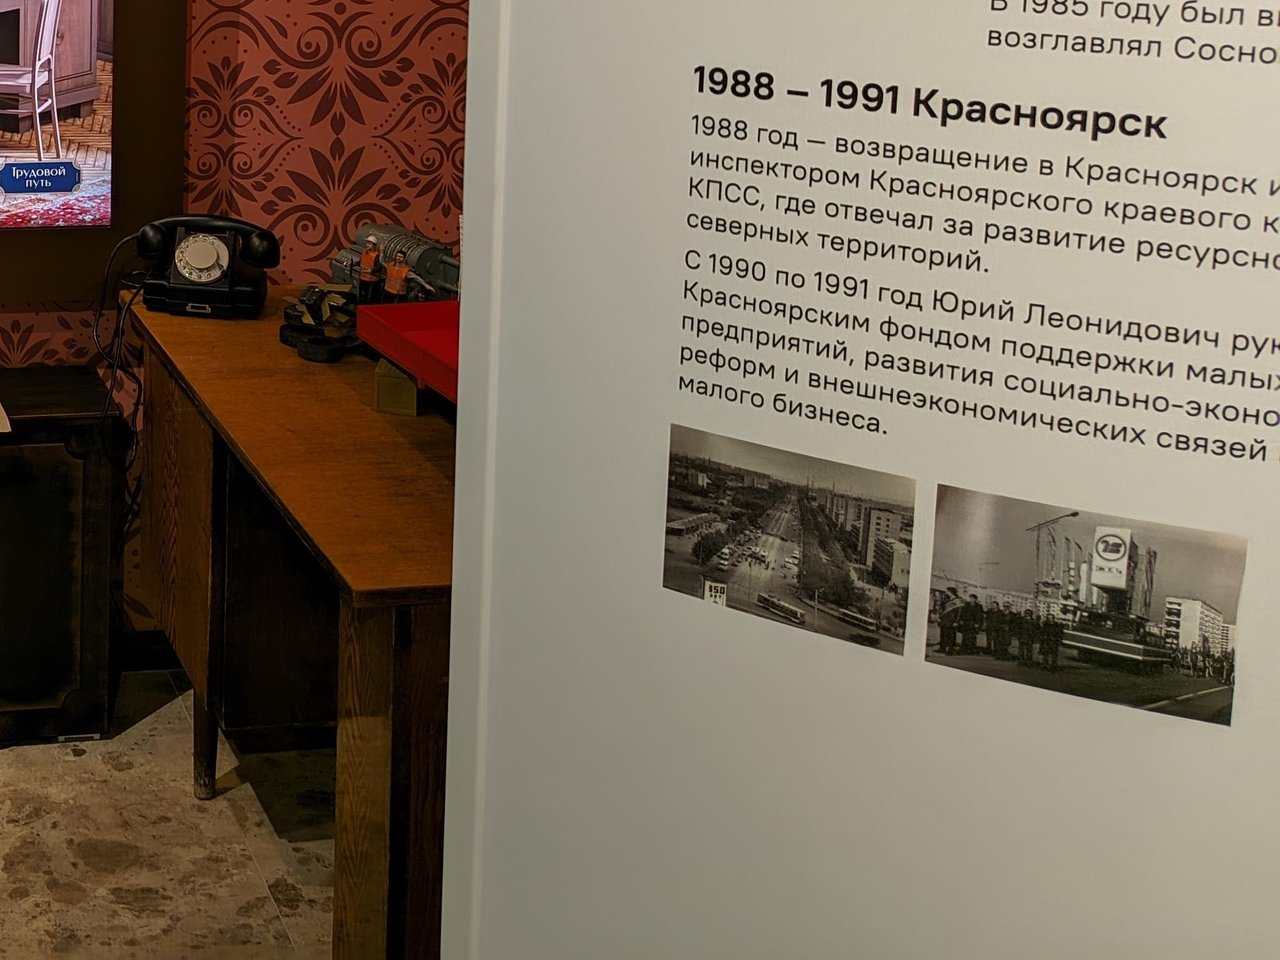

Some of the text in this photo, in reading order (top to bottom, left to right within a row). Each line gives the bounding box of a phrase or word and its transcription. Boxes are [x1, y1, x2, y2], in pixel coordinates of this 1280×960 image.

[693, 65, 775, 101] 1988
[820, 78, 899, 115] 1991
[912, 87, 1168, 142] Красноярск
[12, 165, 66, 179] Трудовой
[25, 178, 52, 189] путь
[686, 213, 989, 273] северных территорий.
[684, 249, 1220, 349] С 1990 по 1991 год Юрий Леонидович
[678, 375, 888, 435] малого бизнеса.
